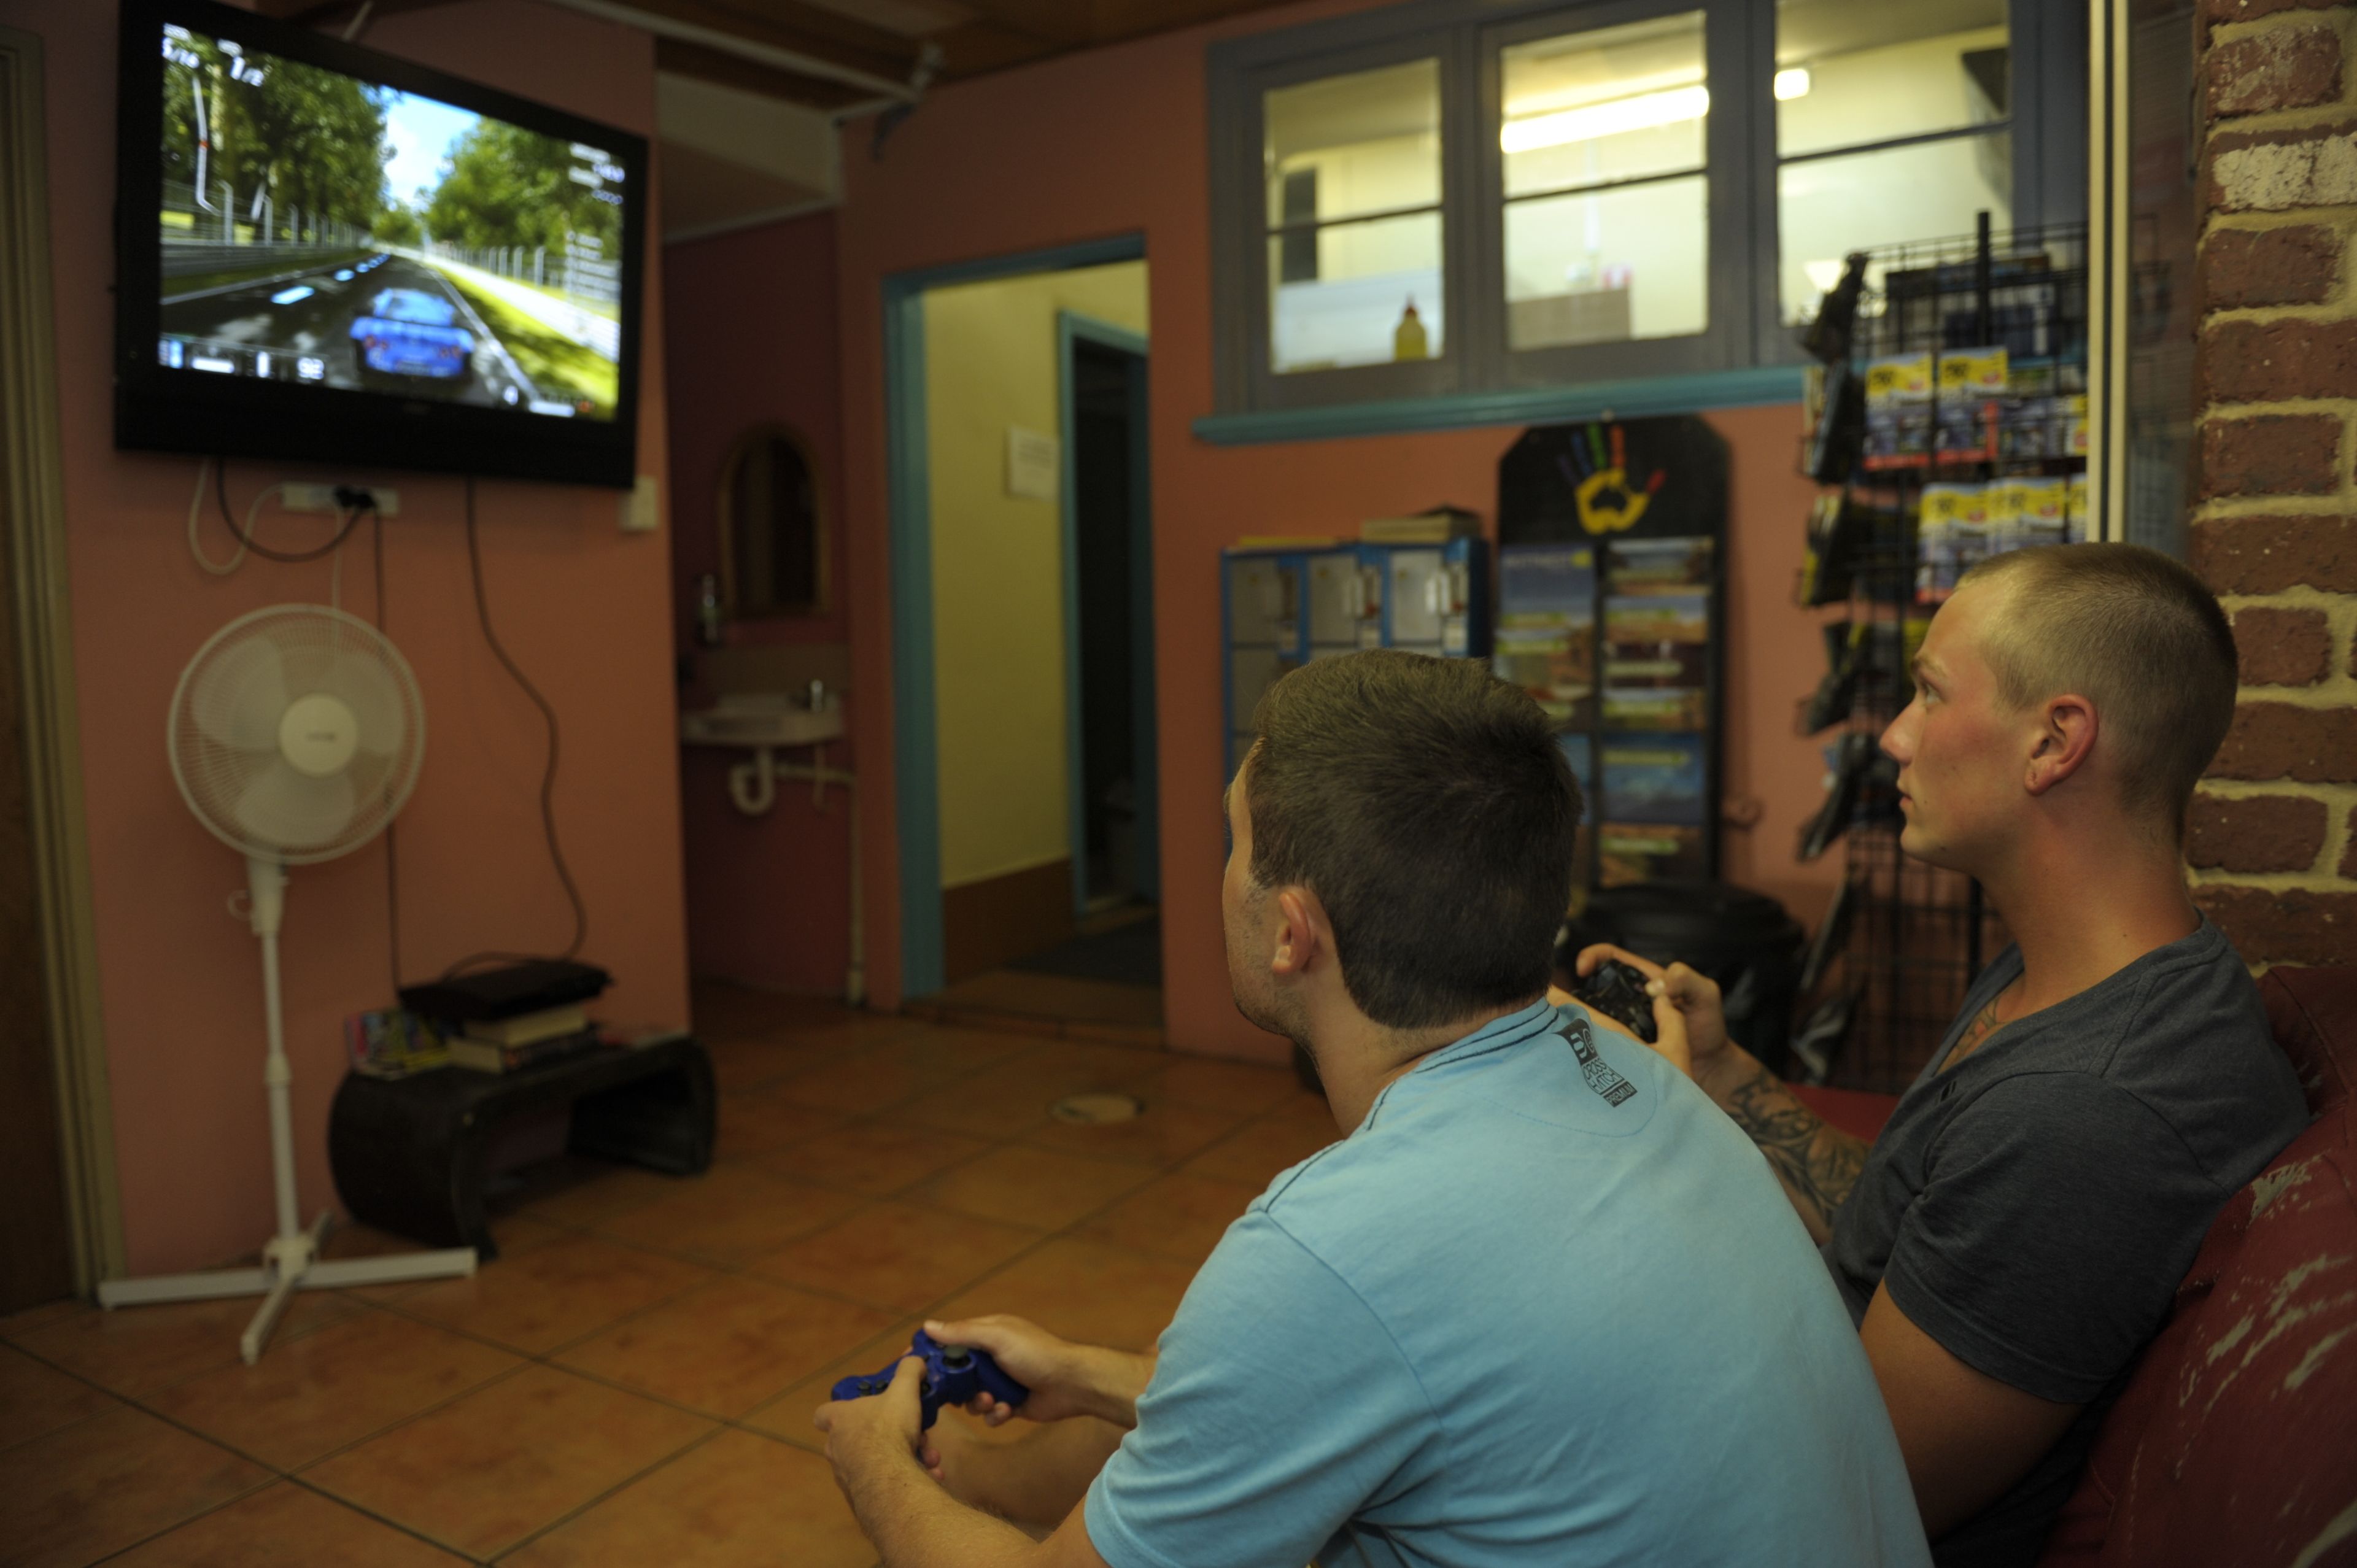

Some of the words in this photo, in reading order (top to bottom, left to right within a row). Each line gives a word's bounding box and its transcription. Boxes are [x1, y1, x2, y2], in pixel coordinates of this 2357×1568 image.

[1583, 1057, 1607, 1080] CROSS
[1589, 1068, 1621, 1094] HATCH
[1605, 1083, 1636, 1105] PREMIUM
